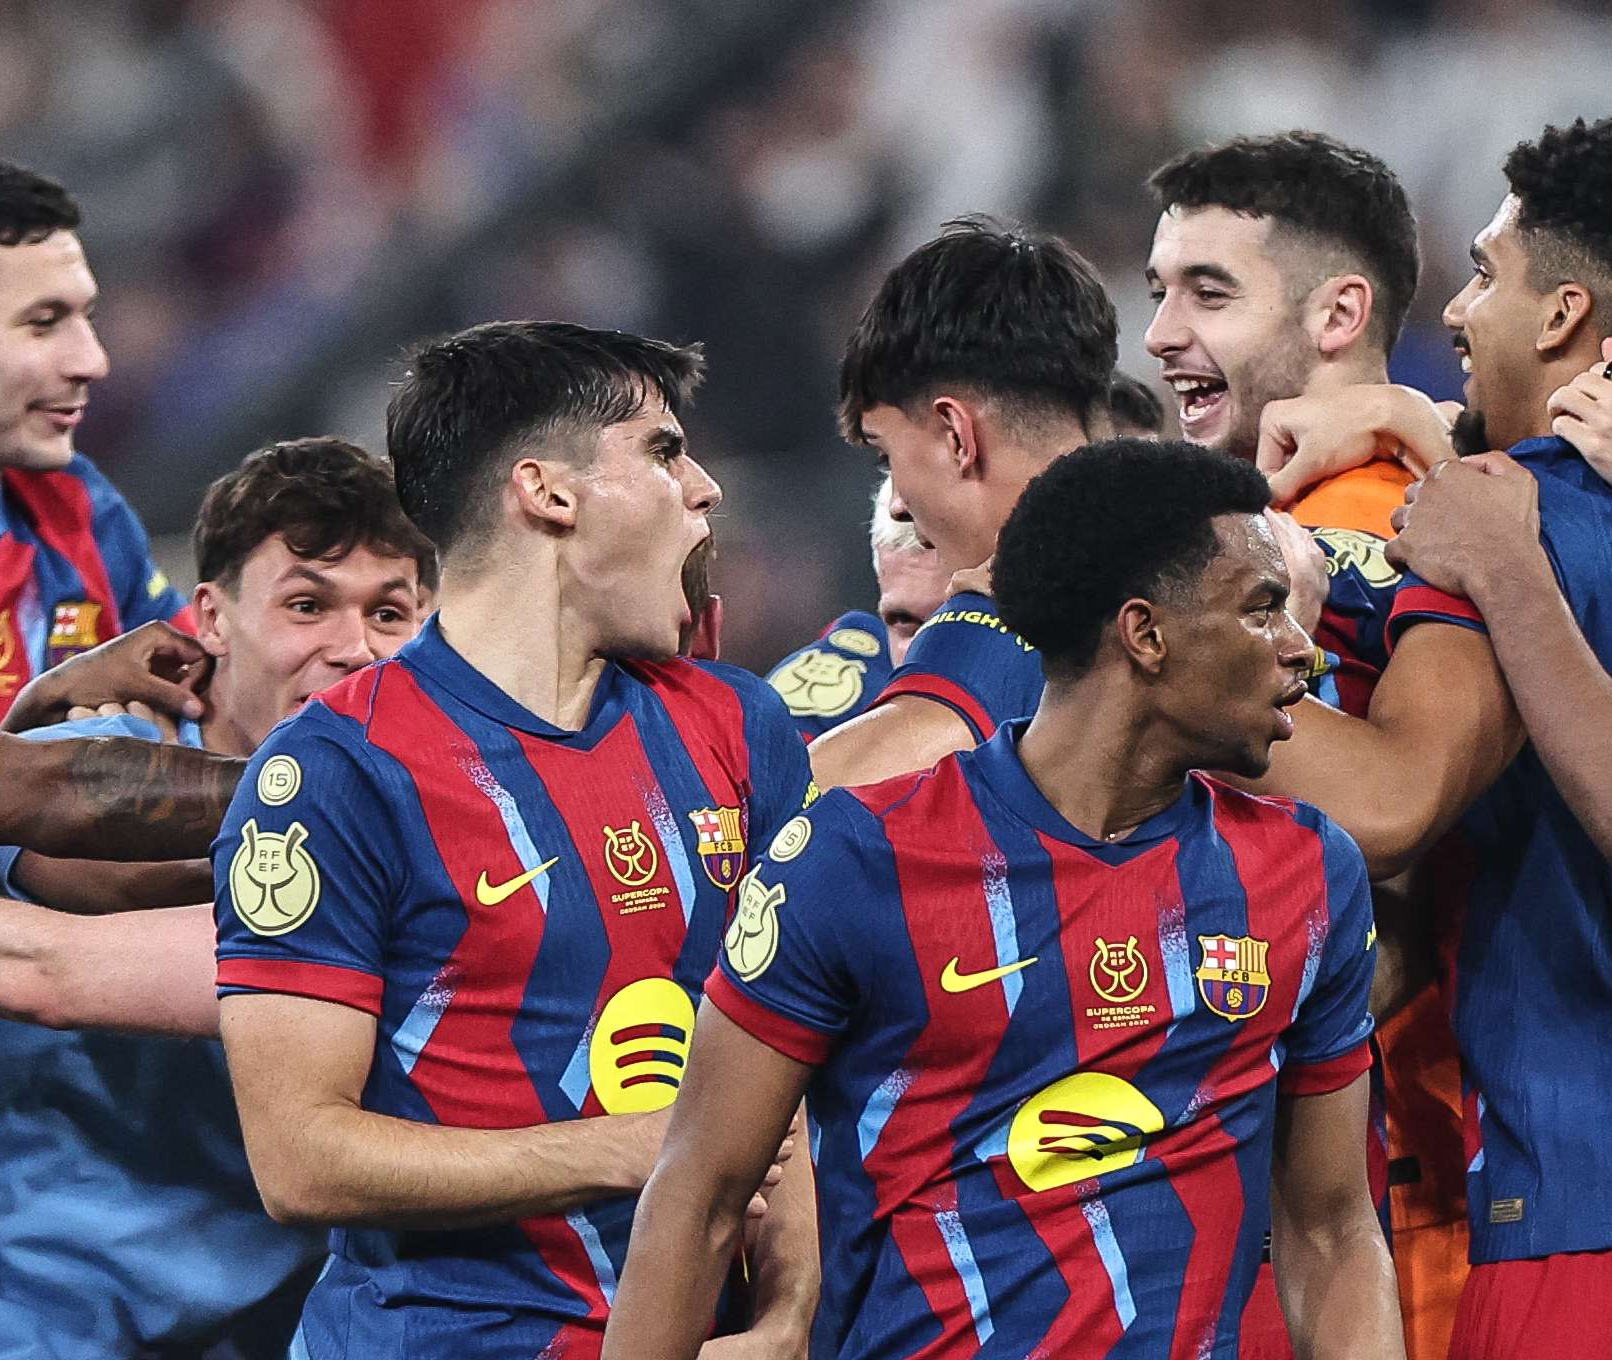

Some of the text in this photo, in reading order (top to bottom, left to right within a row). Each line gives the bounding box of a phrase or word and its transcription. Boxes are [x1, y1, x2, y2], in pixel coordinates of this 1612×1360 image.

[268, 772, 289, 787] 15
[713, 841, 733, 852] FCB
[258, 850, 281, 860] RF
[258, 862, 280, 872] EF
[611, 886, 671, 903] SUPERCOPA
[1220, 969, 1251, 983] FCB
[1086, 1004, 1156, 1017] SUPERCOPA
